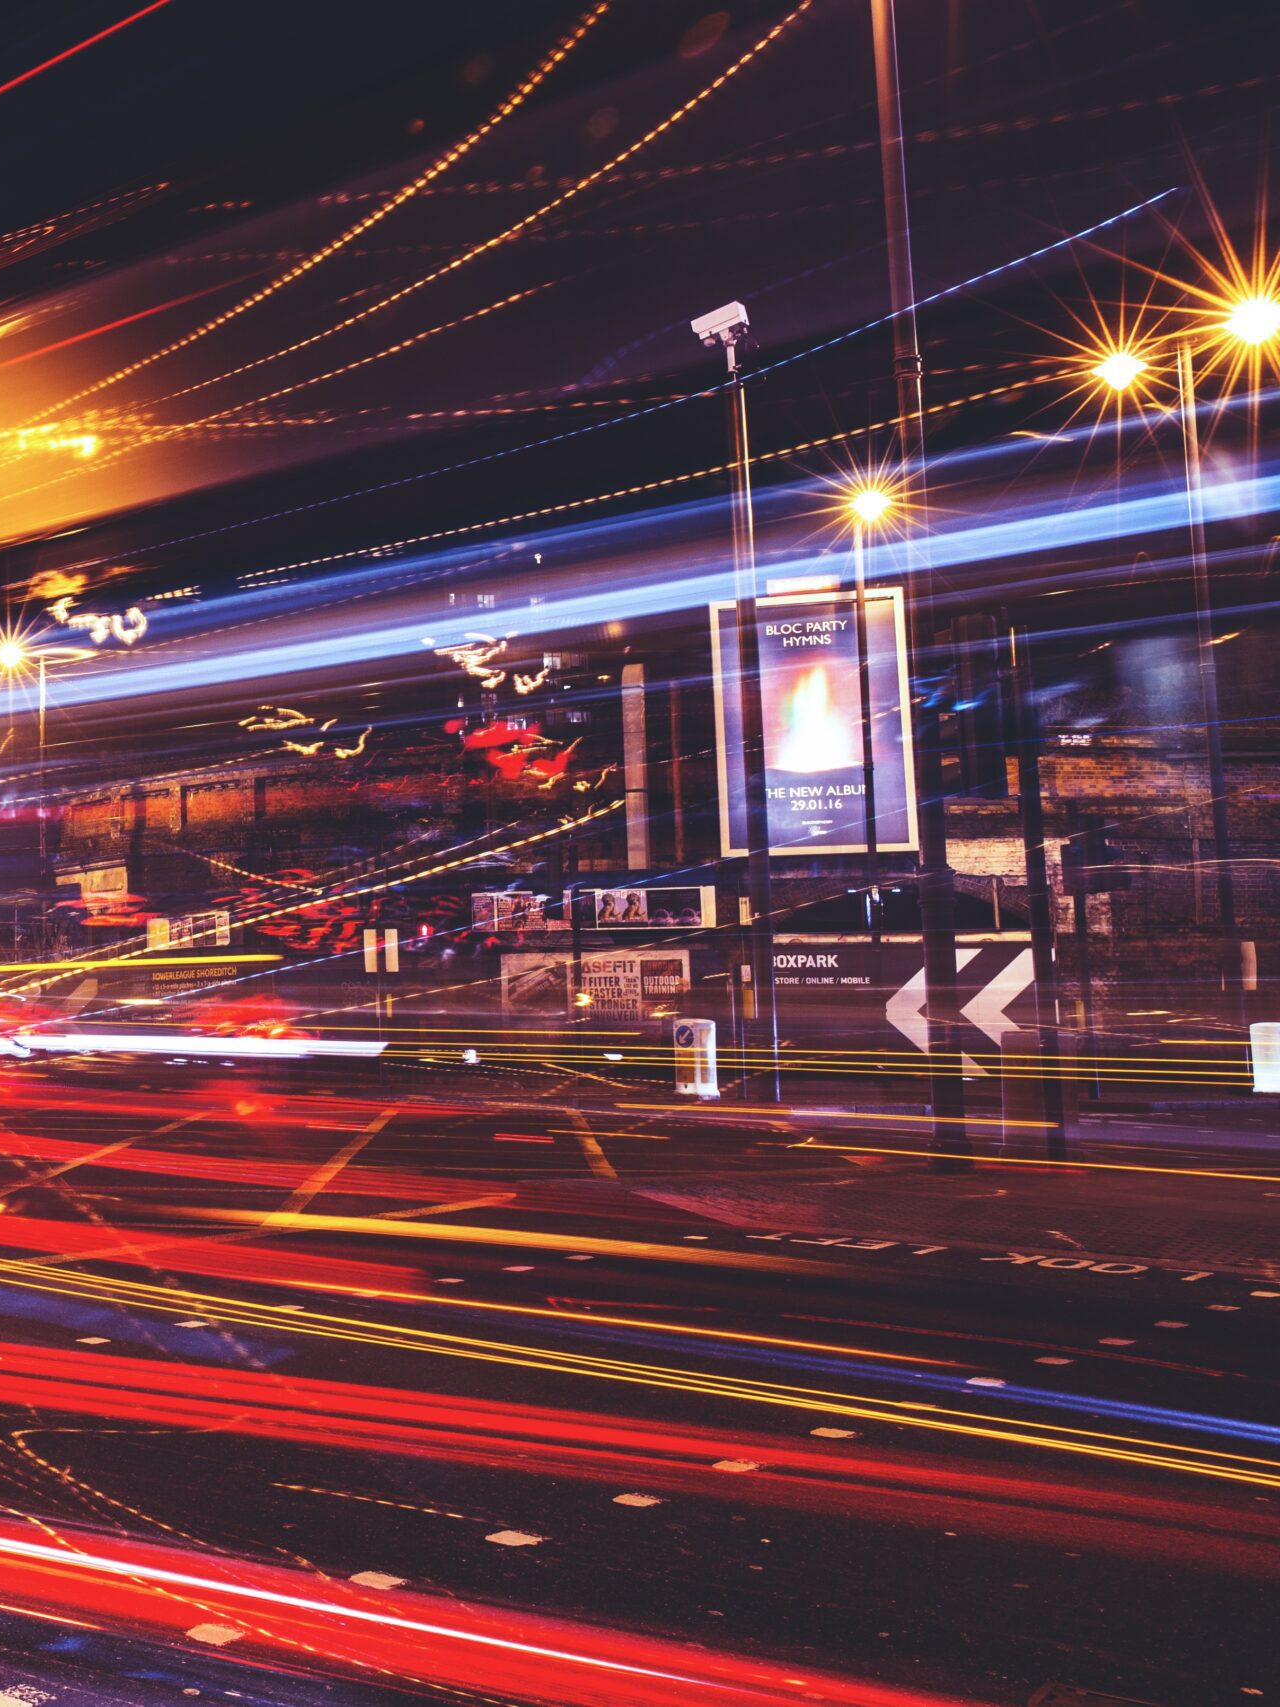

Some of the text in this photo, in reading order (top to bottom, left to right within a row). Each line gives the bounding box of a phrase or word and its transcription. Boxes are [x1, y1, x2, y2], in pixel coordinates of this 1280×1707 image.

[766, 620, 847, 636] BLOC PARTY
[783, 634, 832, 647] HYMNS
[789, 785, 823, 798] NEW
[791, 798, 843, 811] 29.01.16
[196, 966, 237, 979] SHOREDITCH
[570, 960, 636, 974] ASEFIT
[588, 976, 620, 988] FITTER
[774, 976, 800, 985] STORE
[805, 976, 834, 985] ONLINE
[840, 976, 871, 985] MOBILE
[589, 987, 623, 999] FASTER
[644, 985, 677, 994] TRAININ
[589, 999, 637, 1010] STRONGER
[745, 1231, 1214, 1281] LOOK LEFT
